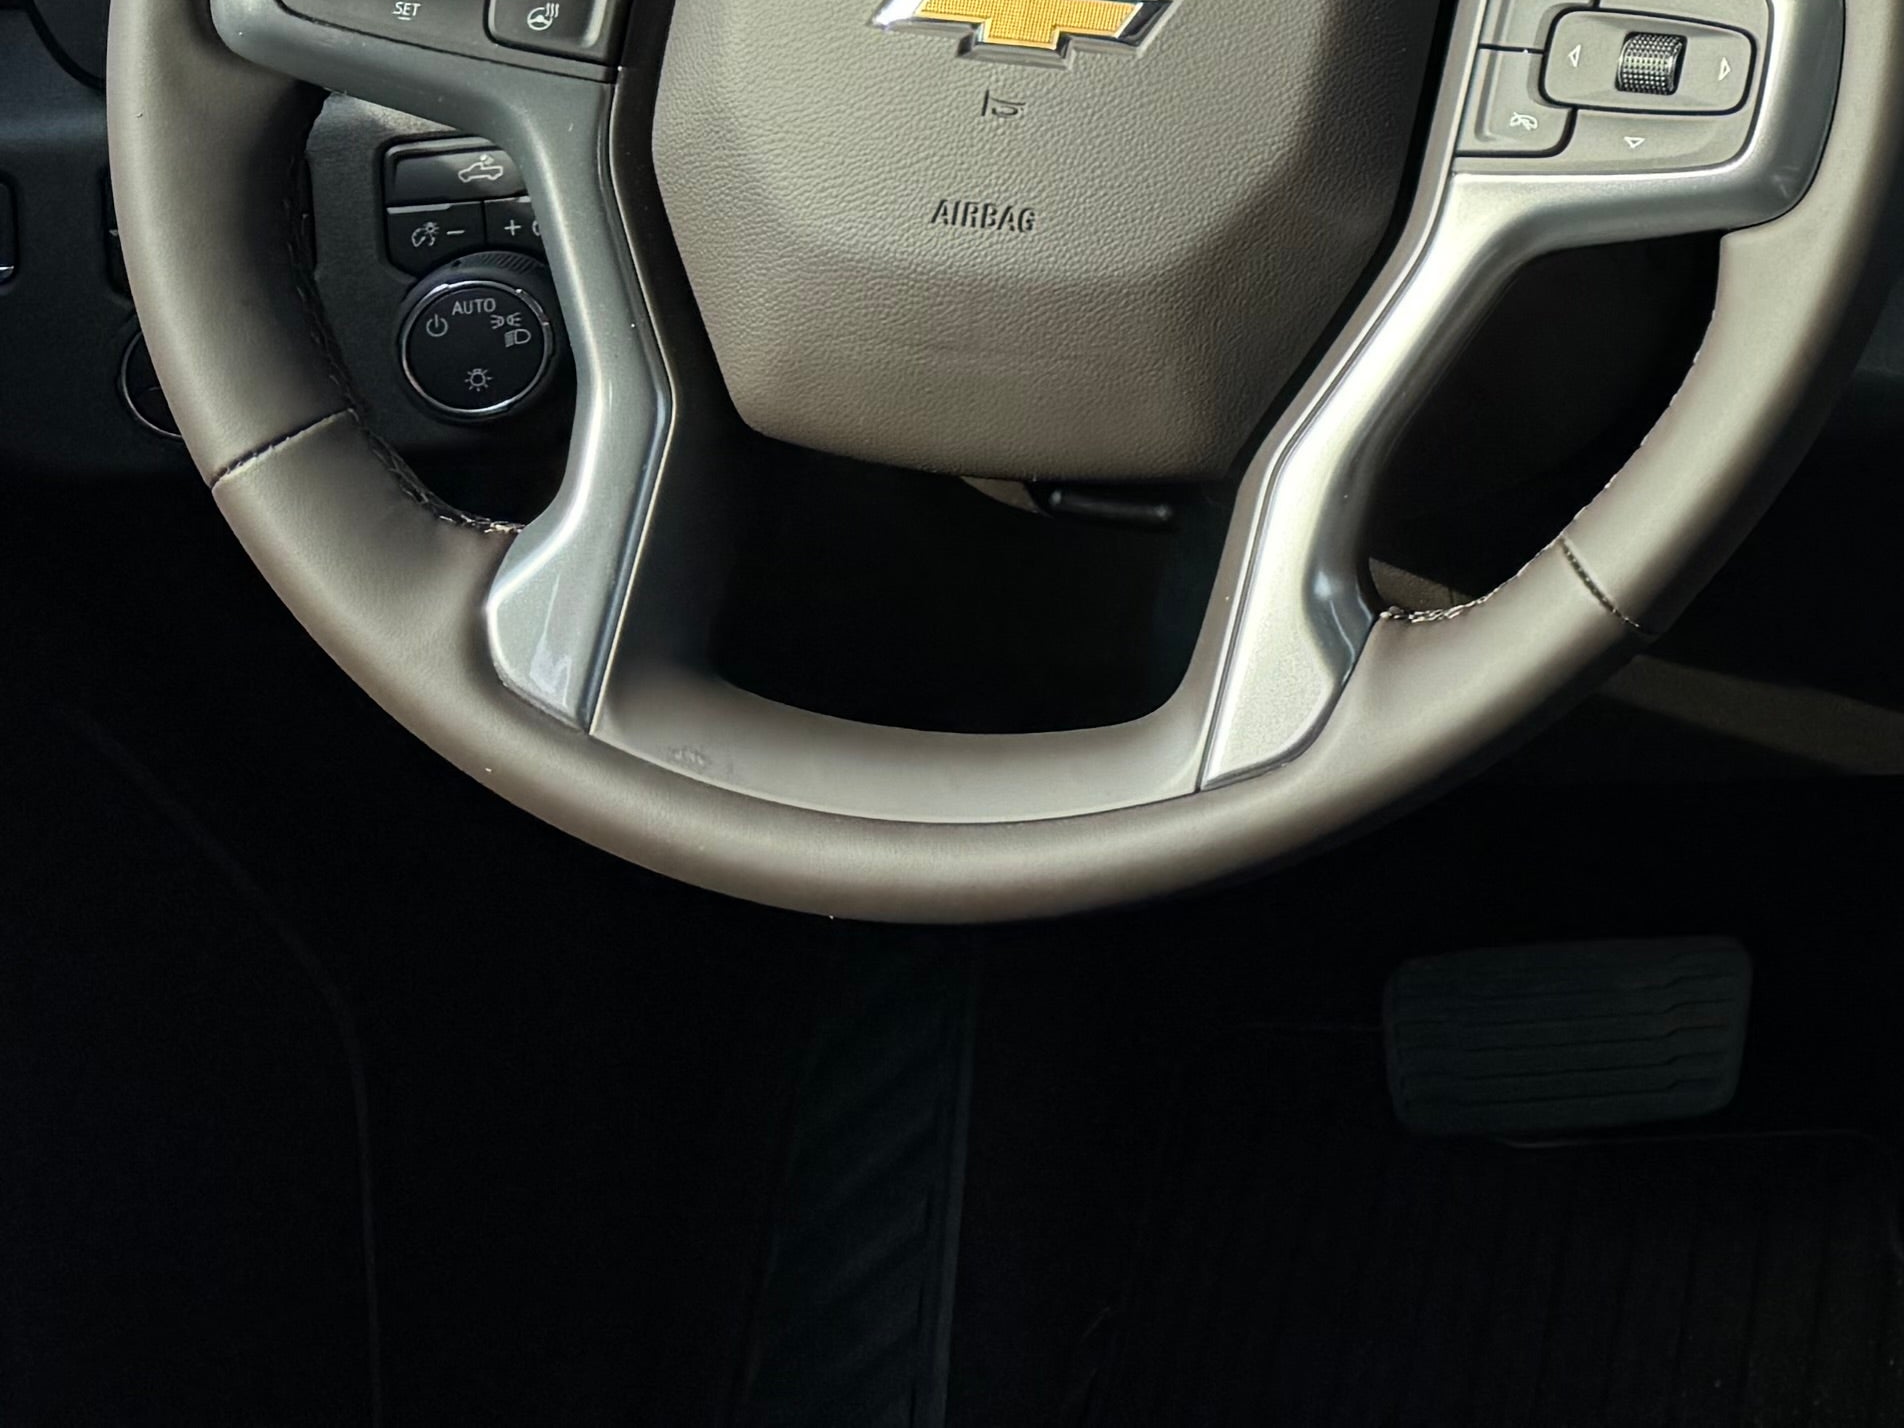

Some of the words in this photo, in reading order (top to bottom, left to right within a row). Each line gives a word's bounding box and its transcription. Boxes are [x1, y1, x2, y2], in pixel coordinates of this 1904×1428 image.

[392, 1, 420, 17] SET
[930, 199, 1037, 233] AIRBAG
[451, 298, 497, 316] AUTO
